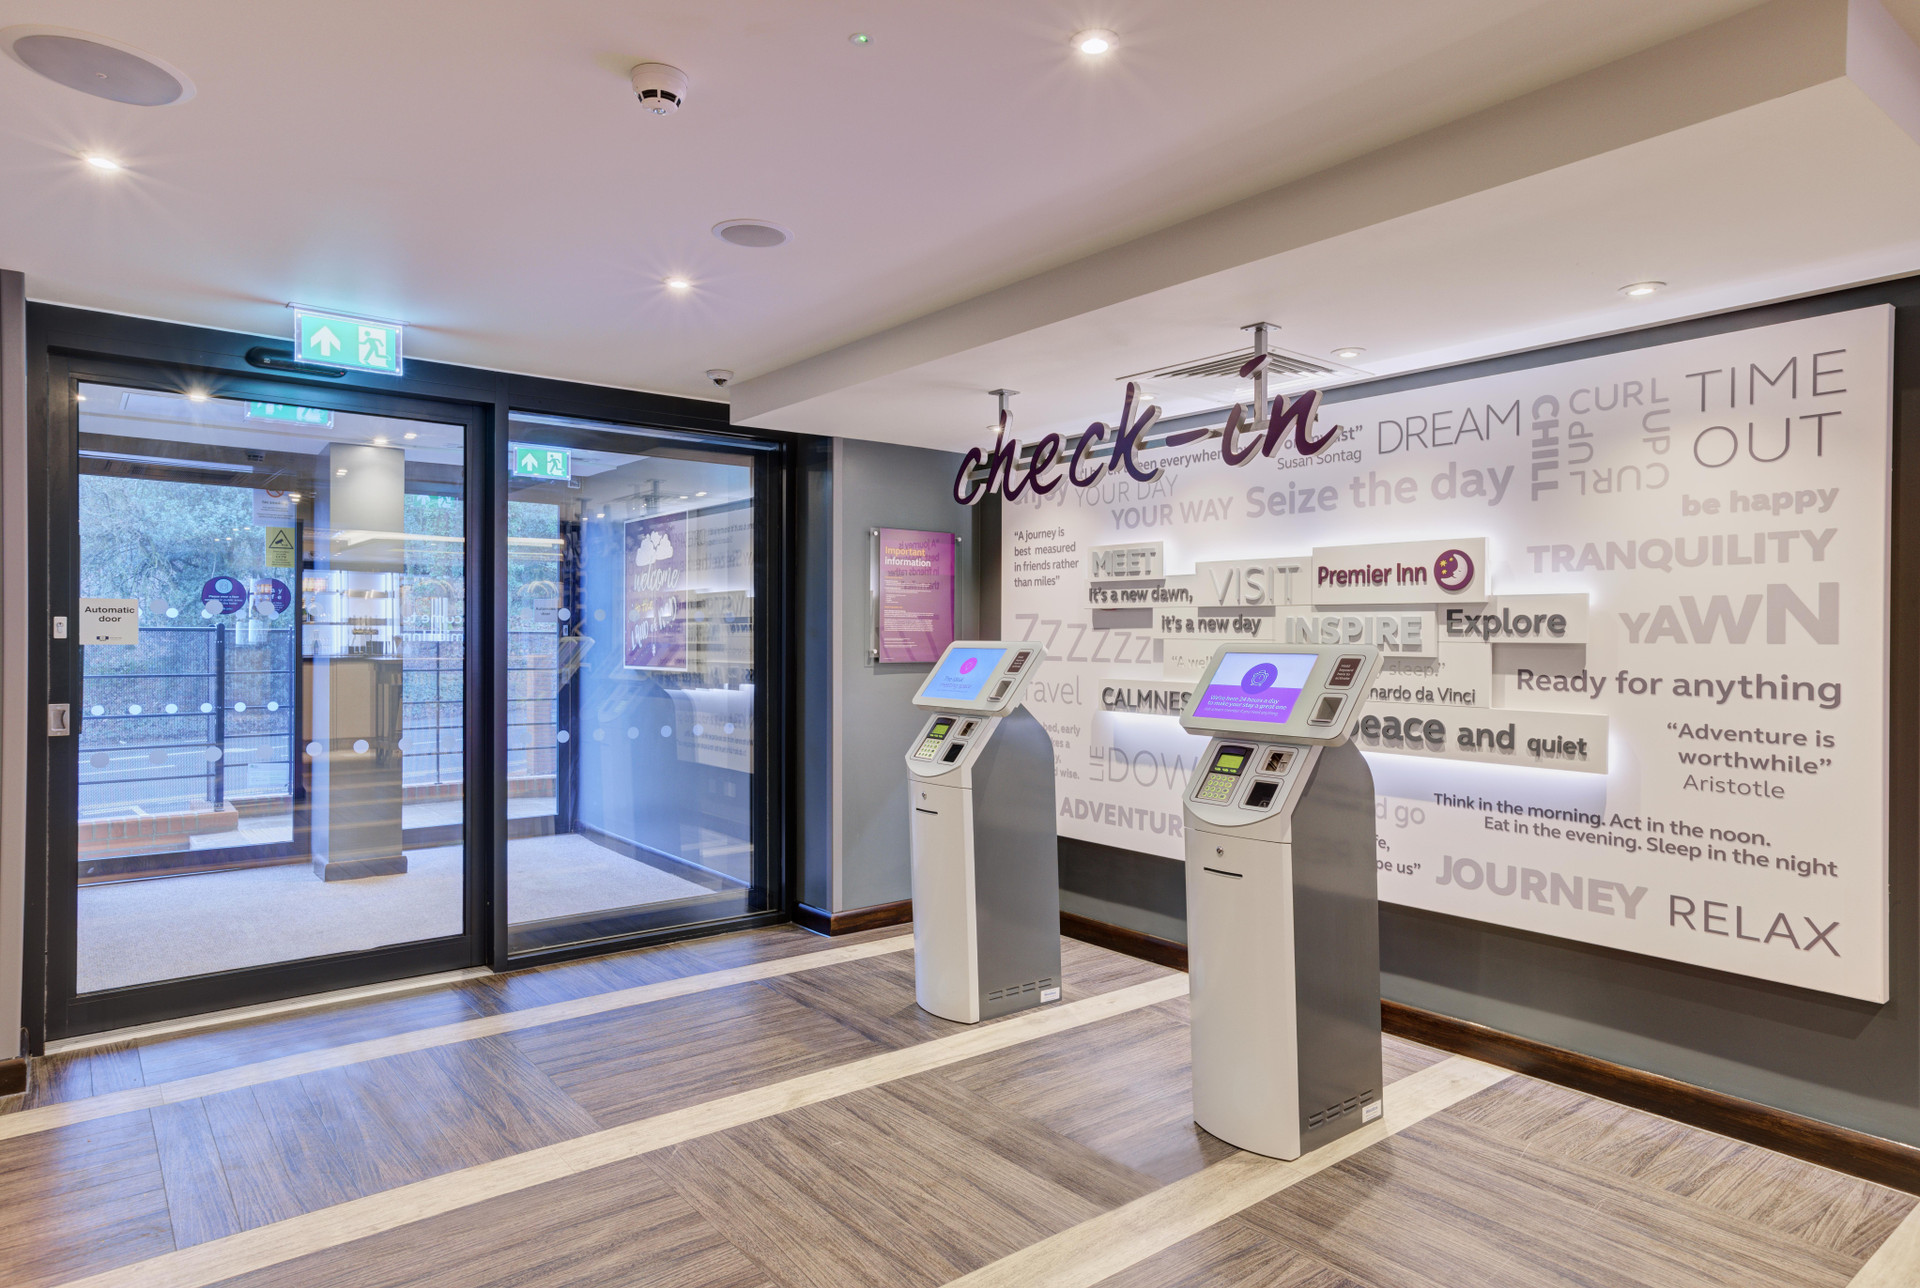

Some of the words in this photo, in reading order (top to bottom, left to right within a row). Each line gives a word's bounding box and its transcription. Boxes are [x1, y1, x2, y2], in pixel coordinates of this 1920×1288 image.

[1569, 377, 1669, 415] CURL
[1685, 349, 1847, 413] TIME
[954, 354, 1345, 507] check-in
[1378, 399, 1521, 455] DREAM
[1568, 421, 1594, 465] UP
[1642, 408, 1671, 456] UP
[1693, 410, 1842, 468] OUT
[1277, 456, 1313, 470] Susan
[1316, 449, 1362, 463] Sontag
[1531, 394, 1560, 502] CHILL
[1075, 481, 1130, 508] YOUR
[1137, 474, 1178, 501] DAY
[1246, 481, 1338, 518] Seize
[1349, 470, 1418, 509] the
[1431, 461, 1515, 507] day
[1568, 462, 1670, 496] CURL
[1112, 503, 1173, 530] YOUR
[1179, 496, 1234, 525] WAY
[1682, 494, 1721, 517] be
[1730, 487, 1840, 516] happy
[885, 546, 926, 557] Important
[1014, 546, 1031, 557] best
[1034, 542, 1076, 556] measured
[1025, 530, 1056, 543] journey
[1058, 527, 1065, 538] is
[1527, 528, 1838, 574] TRANQUILITY
[884, 556, 931, 568] information
[1014, 562, 1022, 572] in
[1023, 559, 1051, 572] friends
[1052, 558, 1079, 570] rather
[1092, 548, 1157, 577] MEET
[1317, 564, 1392, 587] Premier
[1396, 562, 1428, 584] Inn
[1014, 577, 1033, 588] than
[1034, 575, 1060, 587] miles”
[1110, 590, 1120, 602] a
[1121, 589, 1149, 602] new
[1151, 585, 1193, 604] dawn,
[1209, 564, 1303, 606] VISIT
[84, 606, 135, 614] Automatic
[1185, 618, 1194, 632] a
[1198, 618, 1229, 632] new
[1232, 614, 1262, 637] day
[1446, 608, 1567, 641] Explore
[1619, 582, 1840, 645] YAWN
[1286, 616, 1422, 648] INSPIRE
[1368, 685, 1412, 701] nardo
[1415, 686, 1435, 702] da
[1437, 687, 1476, 704] Vinci
[1517, 669, 1607, 699] Ready
[1615, 670, 1663, 695] for
[1672, 673, 1842, 710] anything
[1060, 724, 1081, 737] early
[1457, 723, 1515, 750] and
[1527, 735, 1588, 757] quiet
[1667, 721, 1808, 747] “Adventure
[1815, 730, 1836, 748] is
[1059, 768, 1080, 780] wise.
[1089, 745, 1104, 782] LIE
[1678, 751, 1832, 775] worthwhile”
[1682, 774, 1786, 800] Aristotle
[1394, 804, 1426, 829] go
[1433, 793, 1475, 810] Think
[1479, 797, 1493, 813] in
[1497, 800, 1524, 816] the
[1528, 806, 1606, 828] morning.
[1609, 813, 1642, 831] Act
[1647, 817, 1664, 833] in
[1669, 820, 1704, 838] the
[1709, 828, 1772, 847] noon.
[1484, 816, 1510, 832] Eat
[1514, 820, 1529, 835] in
[1533, 822, 1561, 839] the
[1565, 829, 1642, 853] evening.
[1646, 837, 1702, 861] Sleep
[1708, 845, 1727, 862] in
[1732, 848, 1770, 867] the
[1775, 855, 1839, 877] night
[1436, 854, 1648, 920] JOURNEY
[1669, 894, 1841, 958] RELAX
